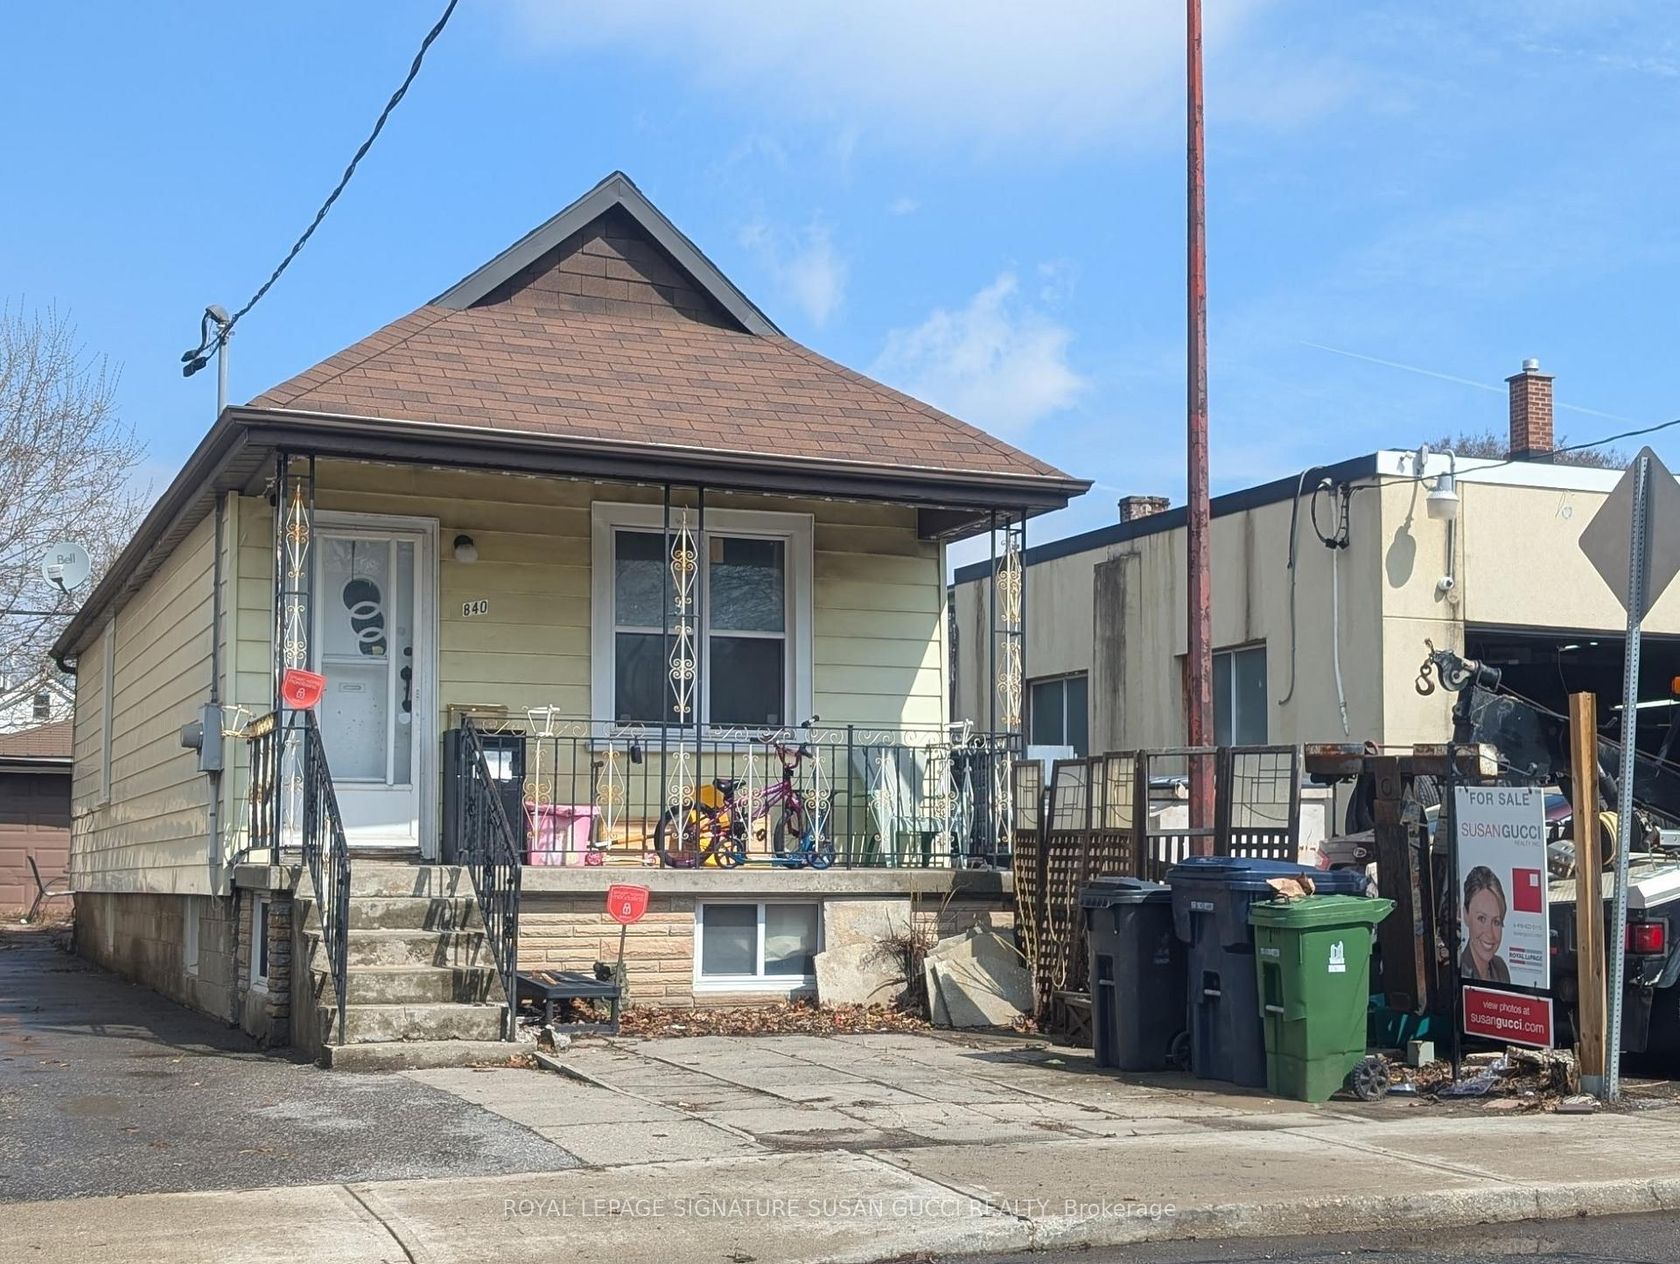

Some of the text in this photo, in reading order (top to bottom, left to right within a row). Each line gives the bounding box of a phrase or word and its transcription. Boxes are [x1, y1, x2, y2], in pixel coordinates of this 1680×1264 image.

[57, 553, 75, 564] Bell
[463, 601, 488, 616] 840
[1470, 792, 1530, 806] FOR SALE
[1482, 1000, 1531, 1016] view photos at
[1470, 1013, 1545, 1034] susangucci.com
